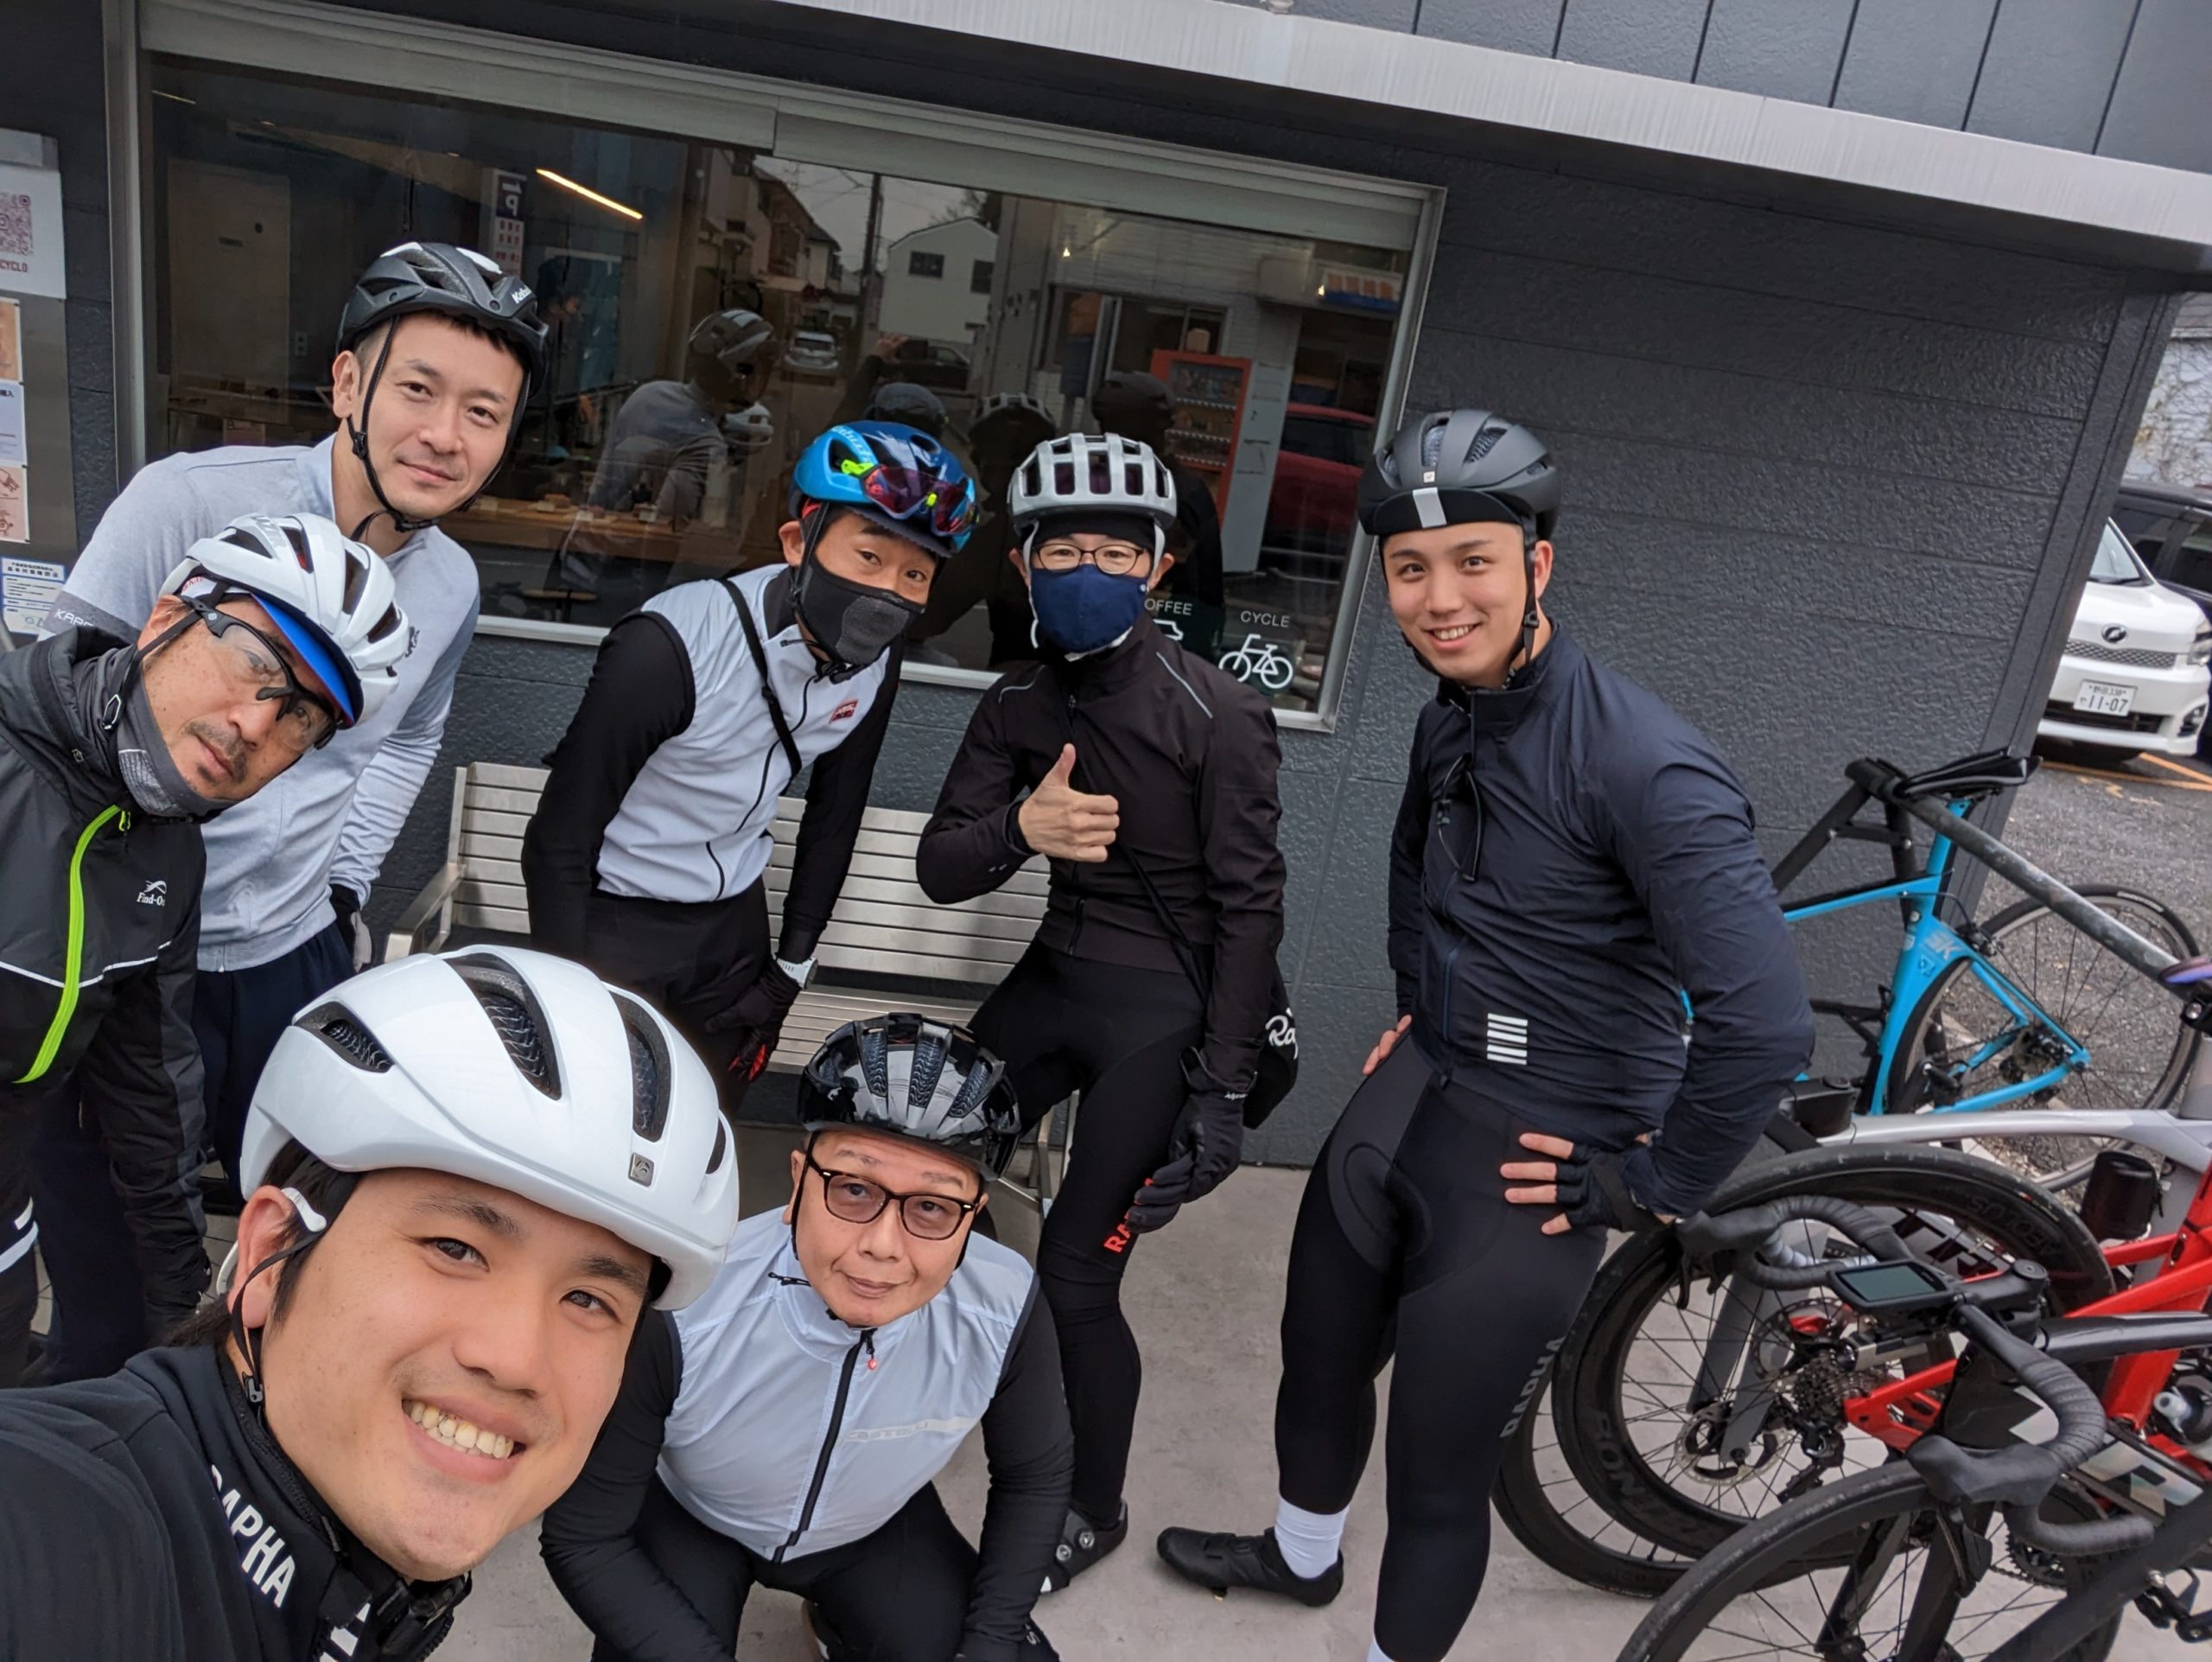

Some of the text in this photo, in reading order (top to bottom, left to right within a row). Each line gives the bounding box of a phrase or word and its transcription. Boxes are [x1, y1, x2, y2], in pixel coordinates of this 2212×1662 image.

[1144, 598, 1192, 616] OFFEE
[1240, 610, 1290, 628] CYCLE
[1891, 1207, 2000, 1275] TR
[2009, 1386, 2203, 1517] TR
